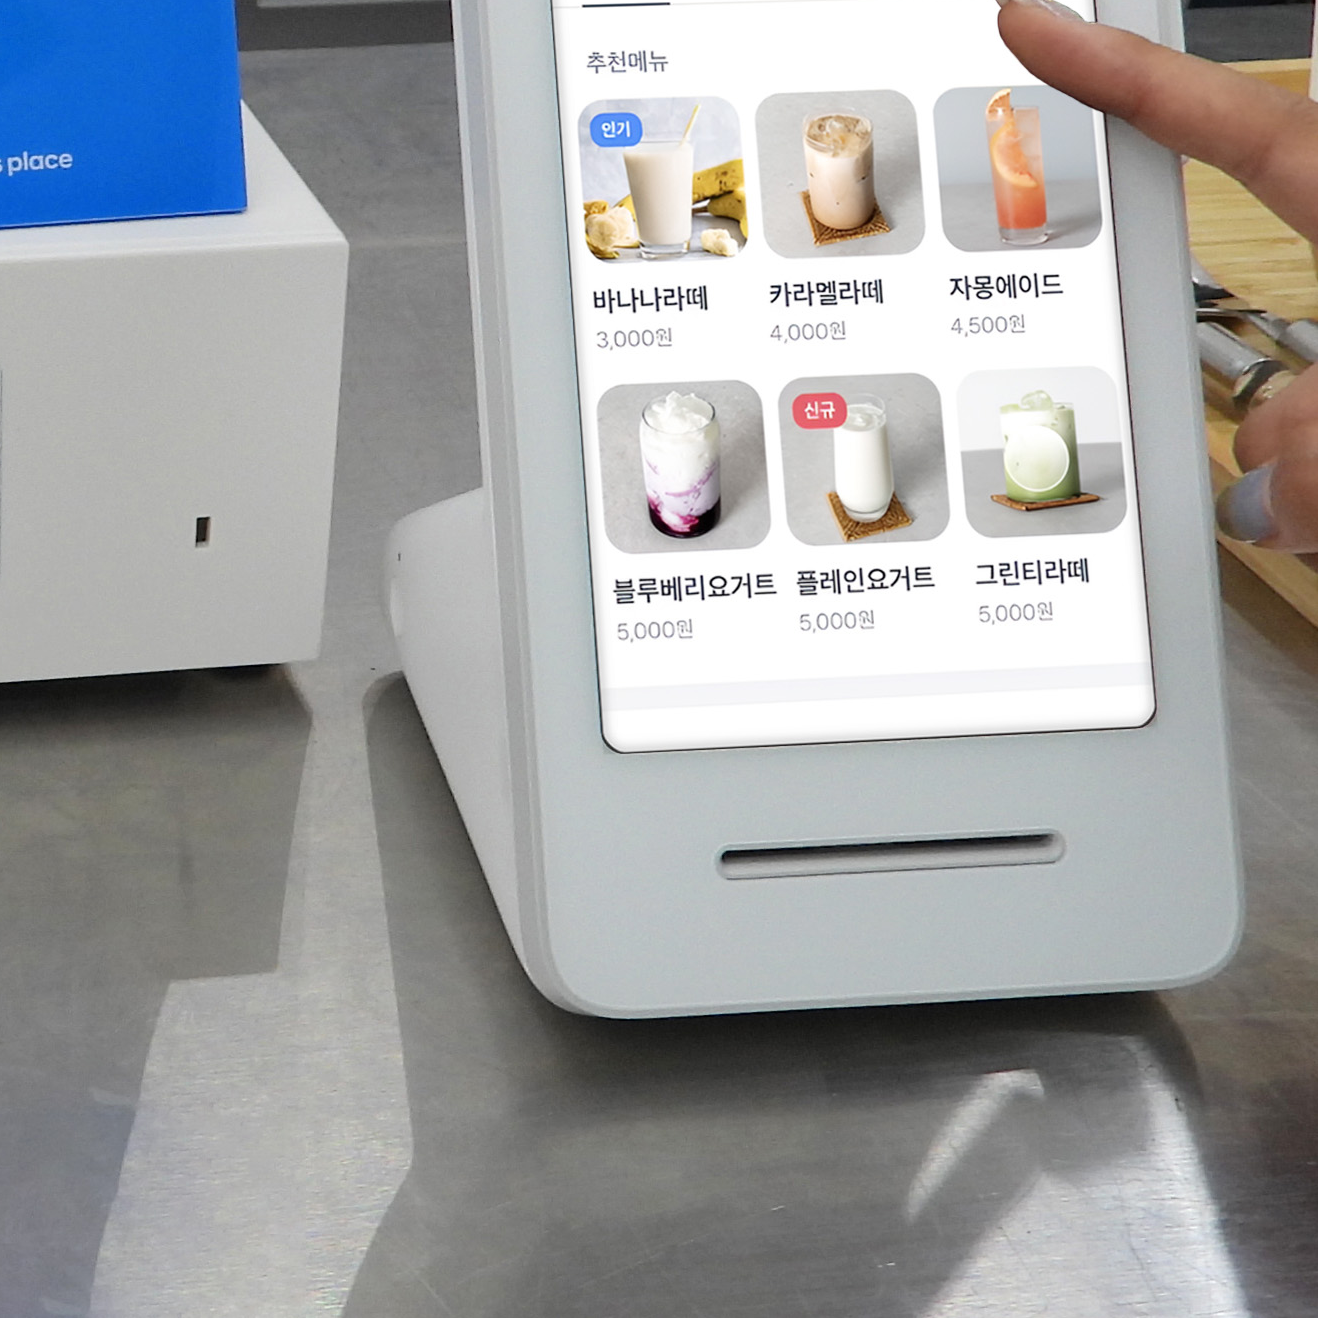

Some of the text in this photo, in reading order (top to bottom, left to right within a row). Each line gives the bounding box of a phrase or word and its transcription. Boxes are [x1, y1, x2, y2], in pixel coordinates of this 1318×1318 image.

[586, 50, 669, 74] 추천메뉴
[601, 120, 631, 139] 인기
[6, 151, 73, 177] place
[769, 279, 884, 308] 카라멜라떼
[949, 272, 1064, 301] 자몽에이드
[593, 285, 708, 314] 바나나라떼
[769, 320, 846, 344] 4,000원
[950, 313, 1026, 338] 4,500원
[596, 327, 673, 351] 3,000원
[804, 400, 836, 420] 신규
[796, 565, 936, 596] 플레인요거트
[975, 558, 1090, 587] 그린티라떼
[613, 573, 778, 605] 블루베리요거트
[799, 609, 875, 633] 5,000원
[978, 601, 1053, 626] 5,000원
[617, 618, 693, 643] 5,000원
